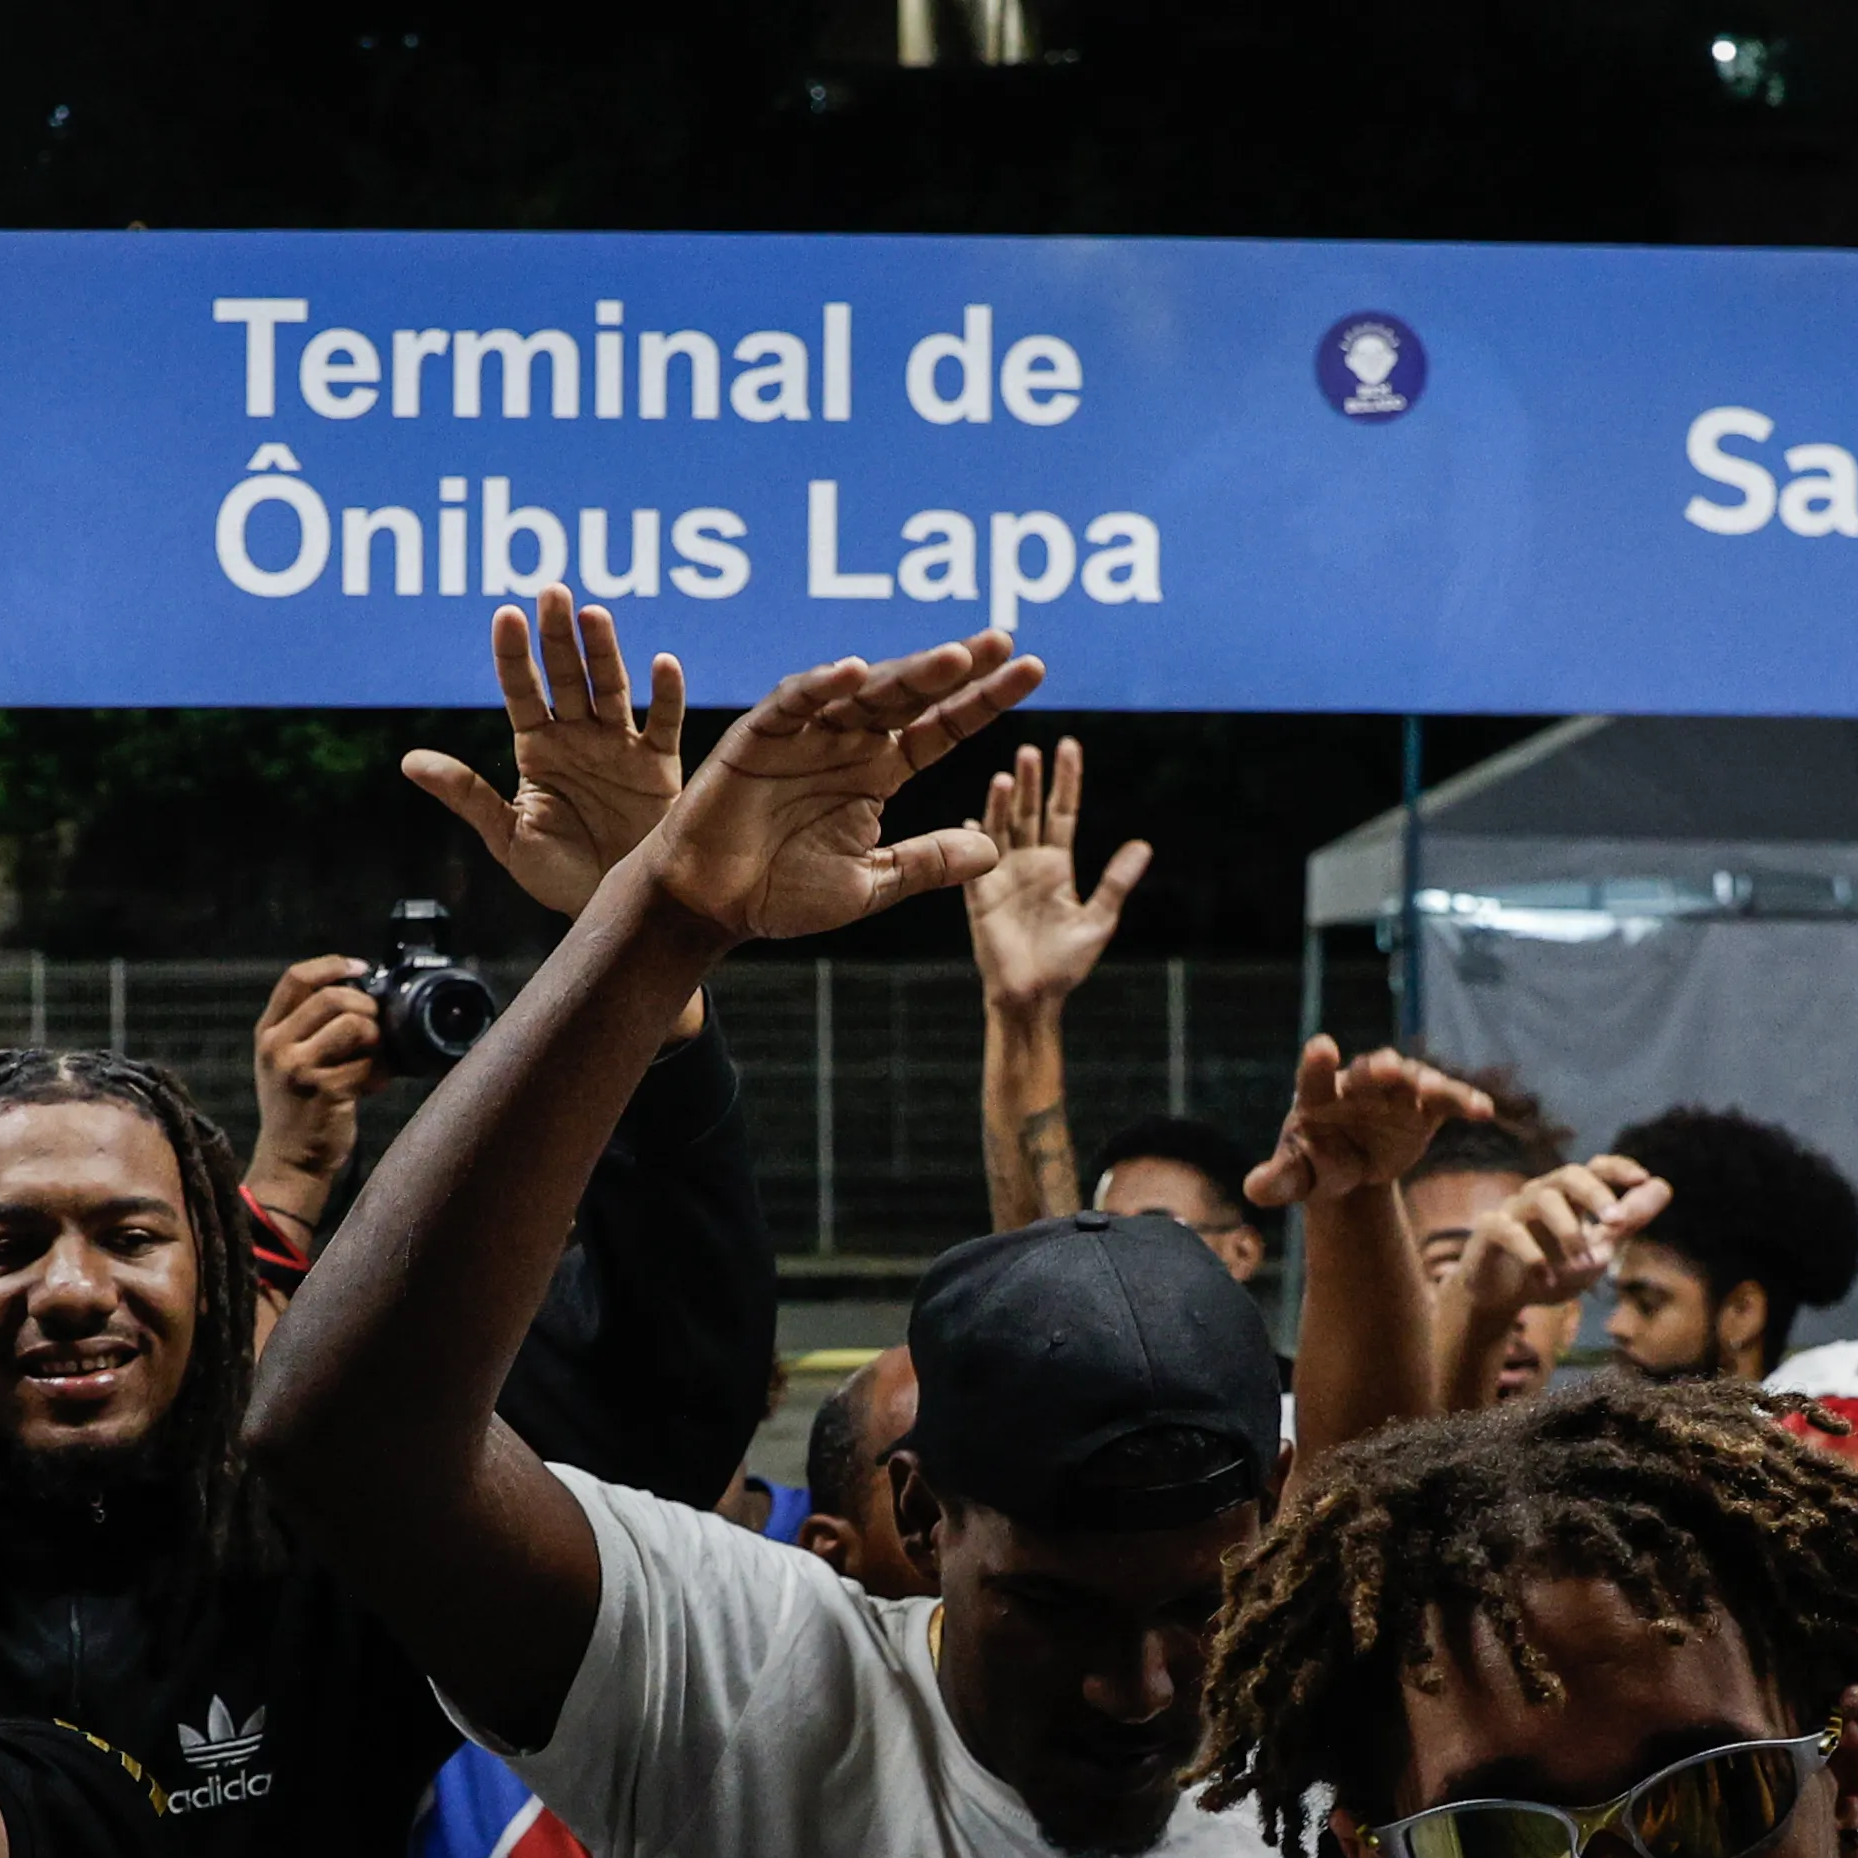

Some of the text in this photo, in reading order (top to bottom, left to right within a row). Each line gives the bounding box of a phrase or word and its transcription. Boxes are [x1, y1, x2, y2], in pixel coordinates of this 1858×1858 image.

[213, 297, 1083, 426] Terminal de
[215, 442, 1163, 632] Ônibus Lapa
[167, 1769, 273, 1815] adida
